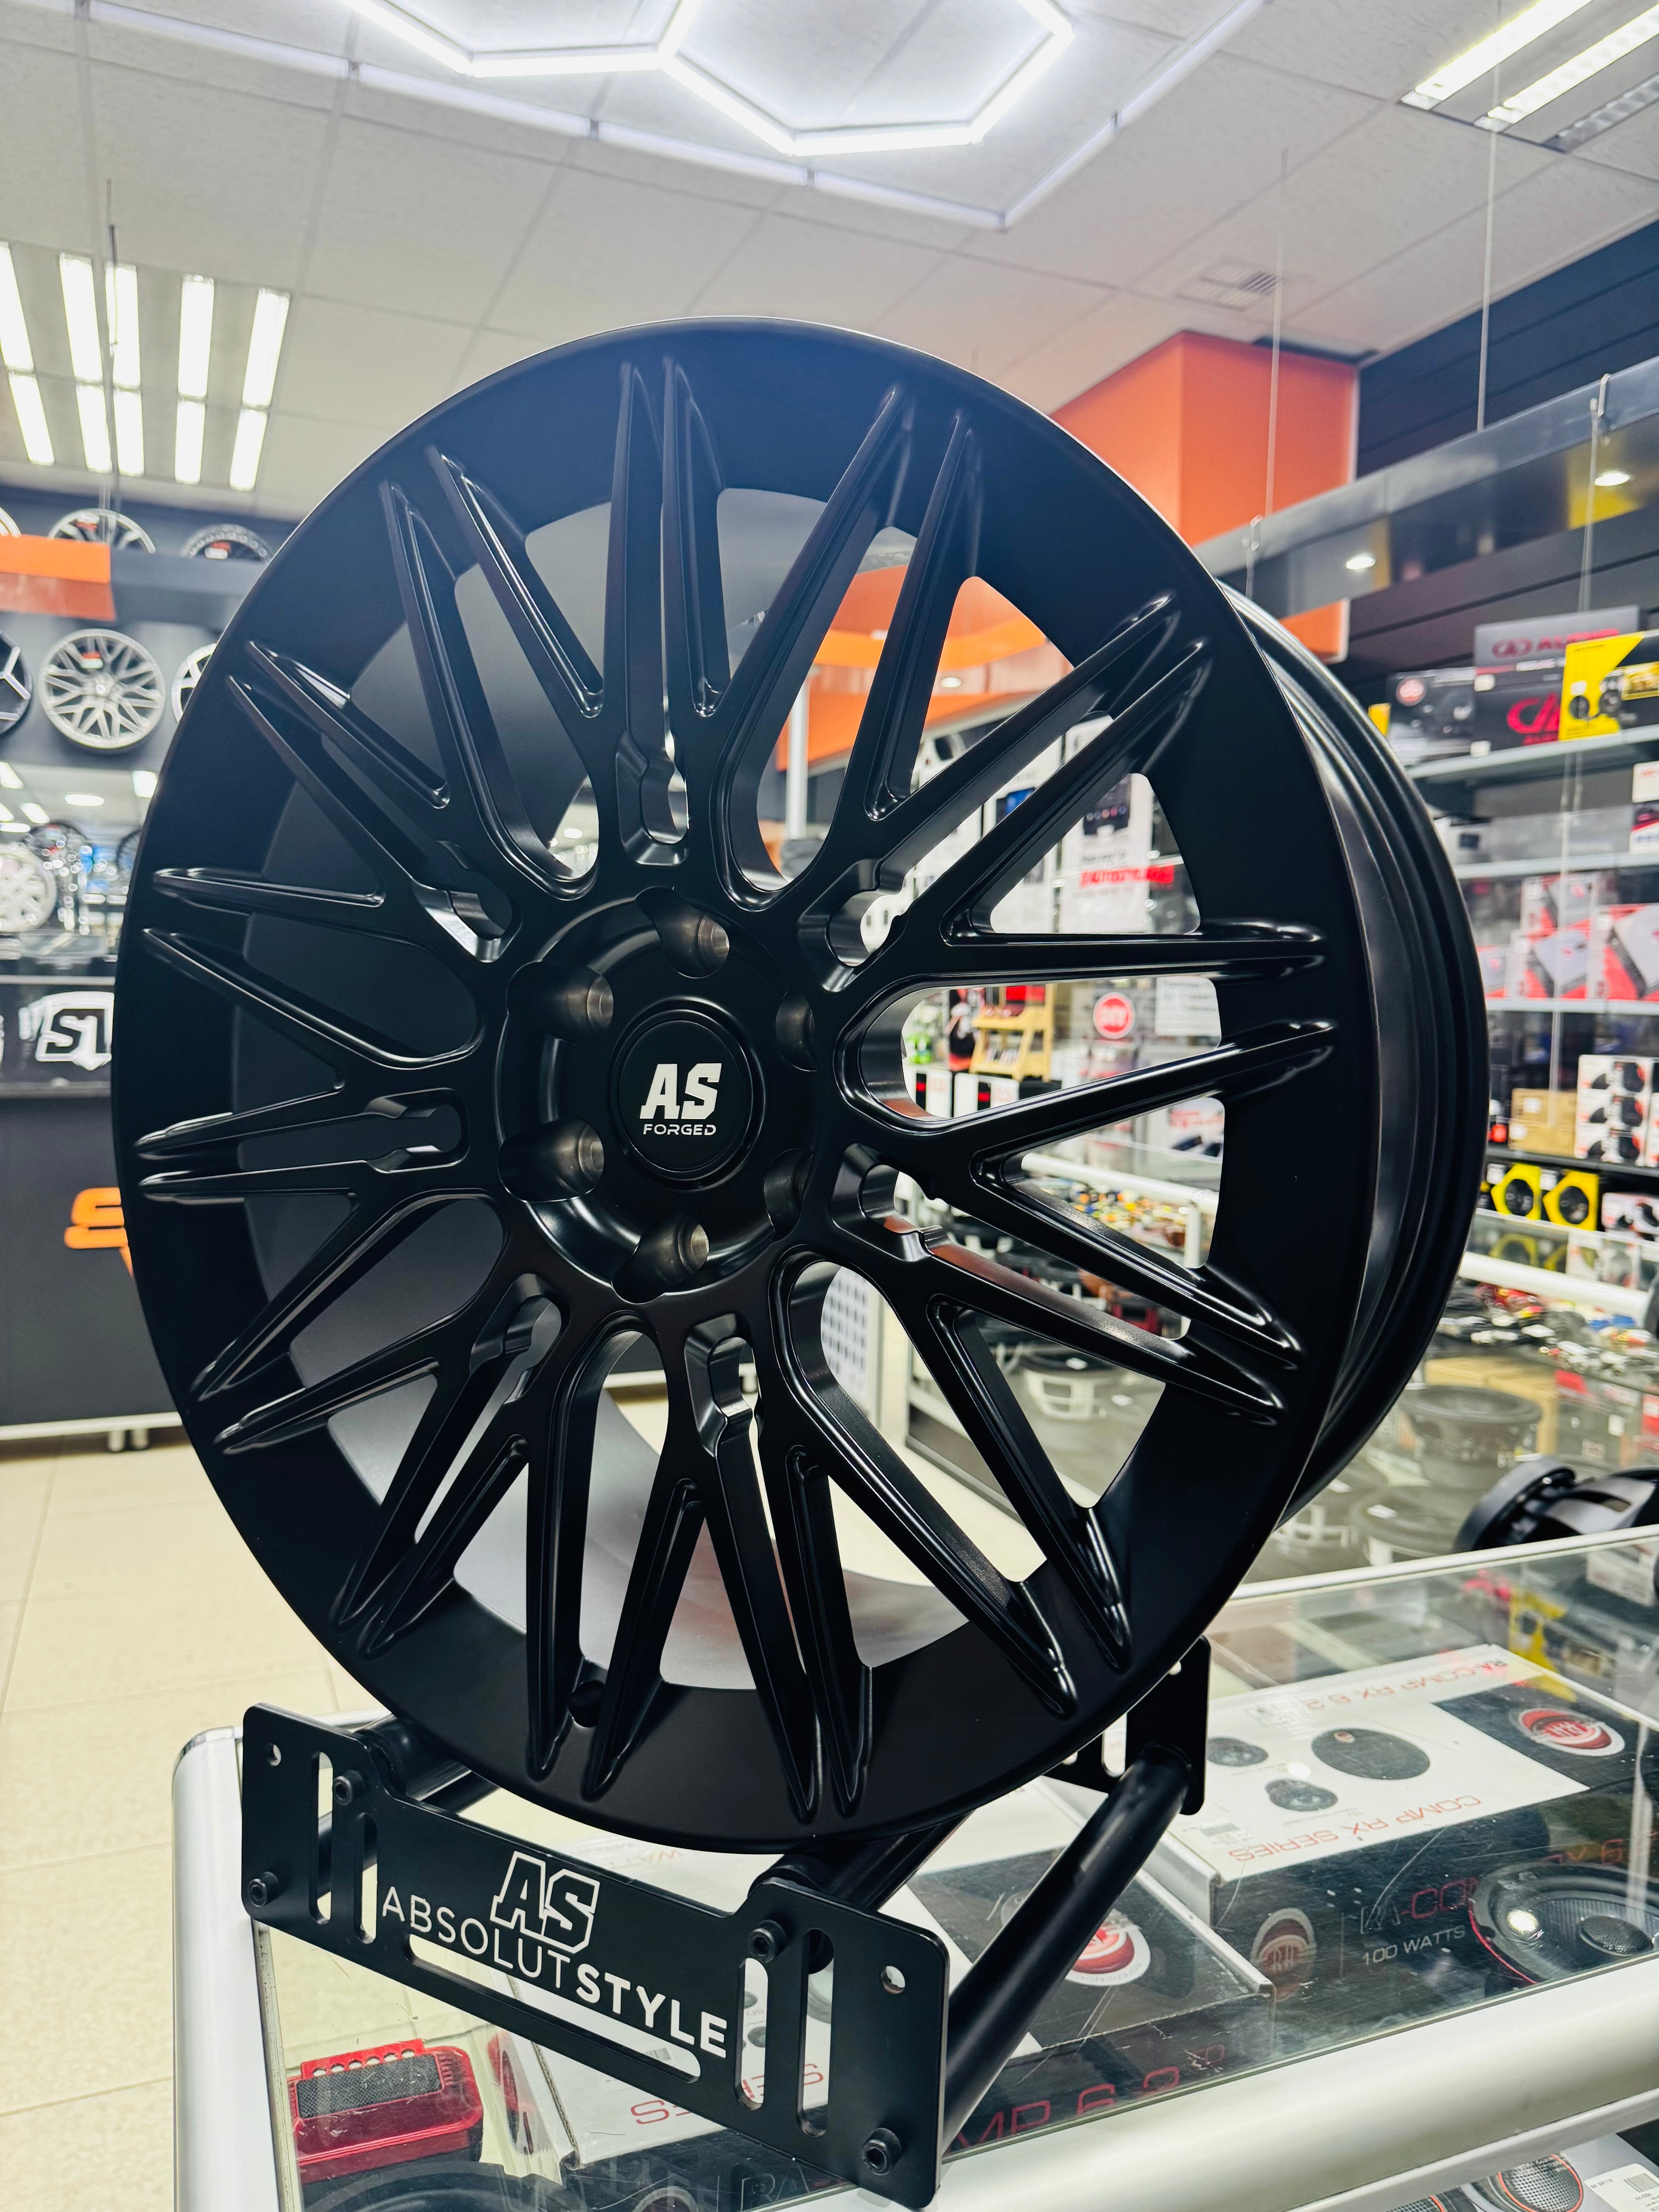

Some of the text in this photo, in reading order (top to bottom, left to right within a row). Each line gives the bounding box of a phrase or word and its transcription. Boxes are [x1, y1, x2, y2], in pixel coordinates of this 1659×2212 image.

[639, 1063, 722, 1120] AS
[643, 1123, 716, 1136] FORGED
[1396, 1794, 1482, 1826] COMP
[1228, 1828, 1340, 1862] SERIES
[490, 1851, 600, 1954] AS
[1362, 1924, 1466, 1966] 100 WATTS
